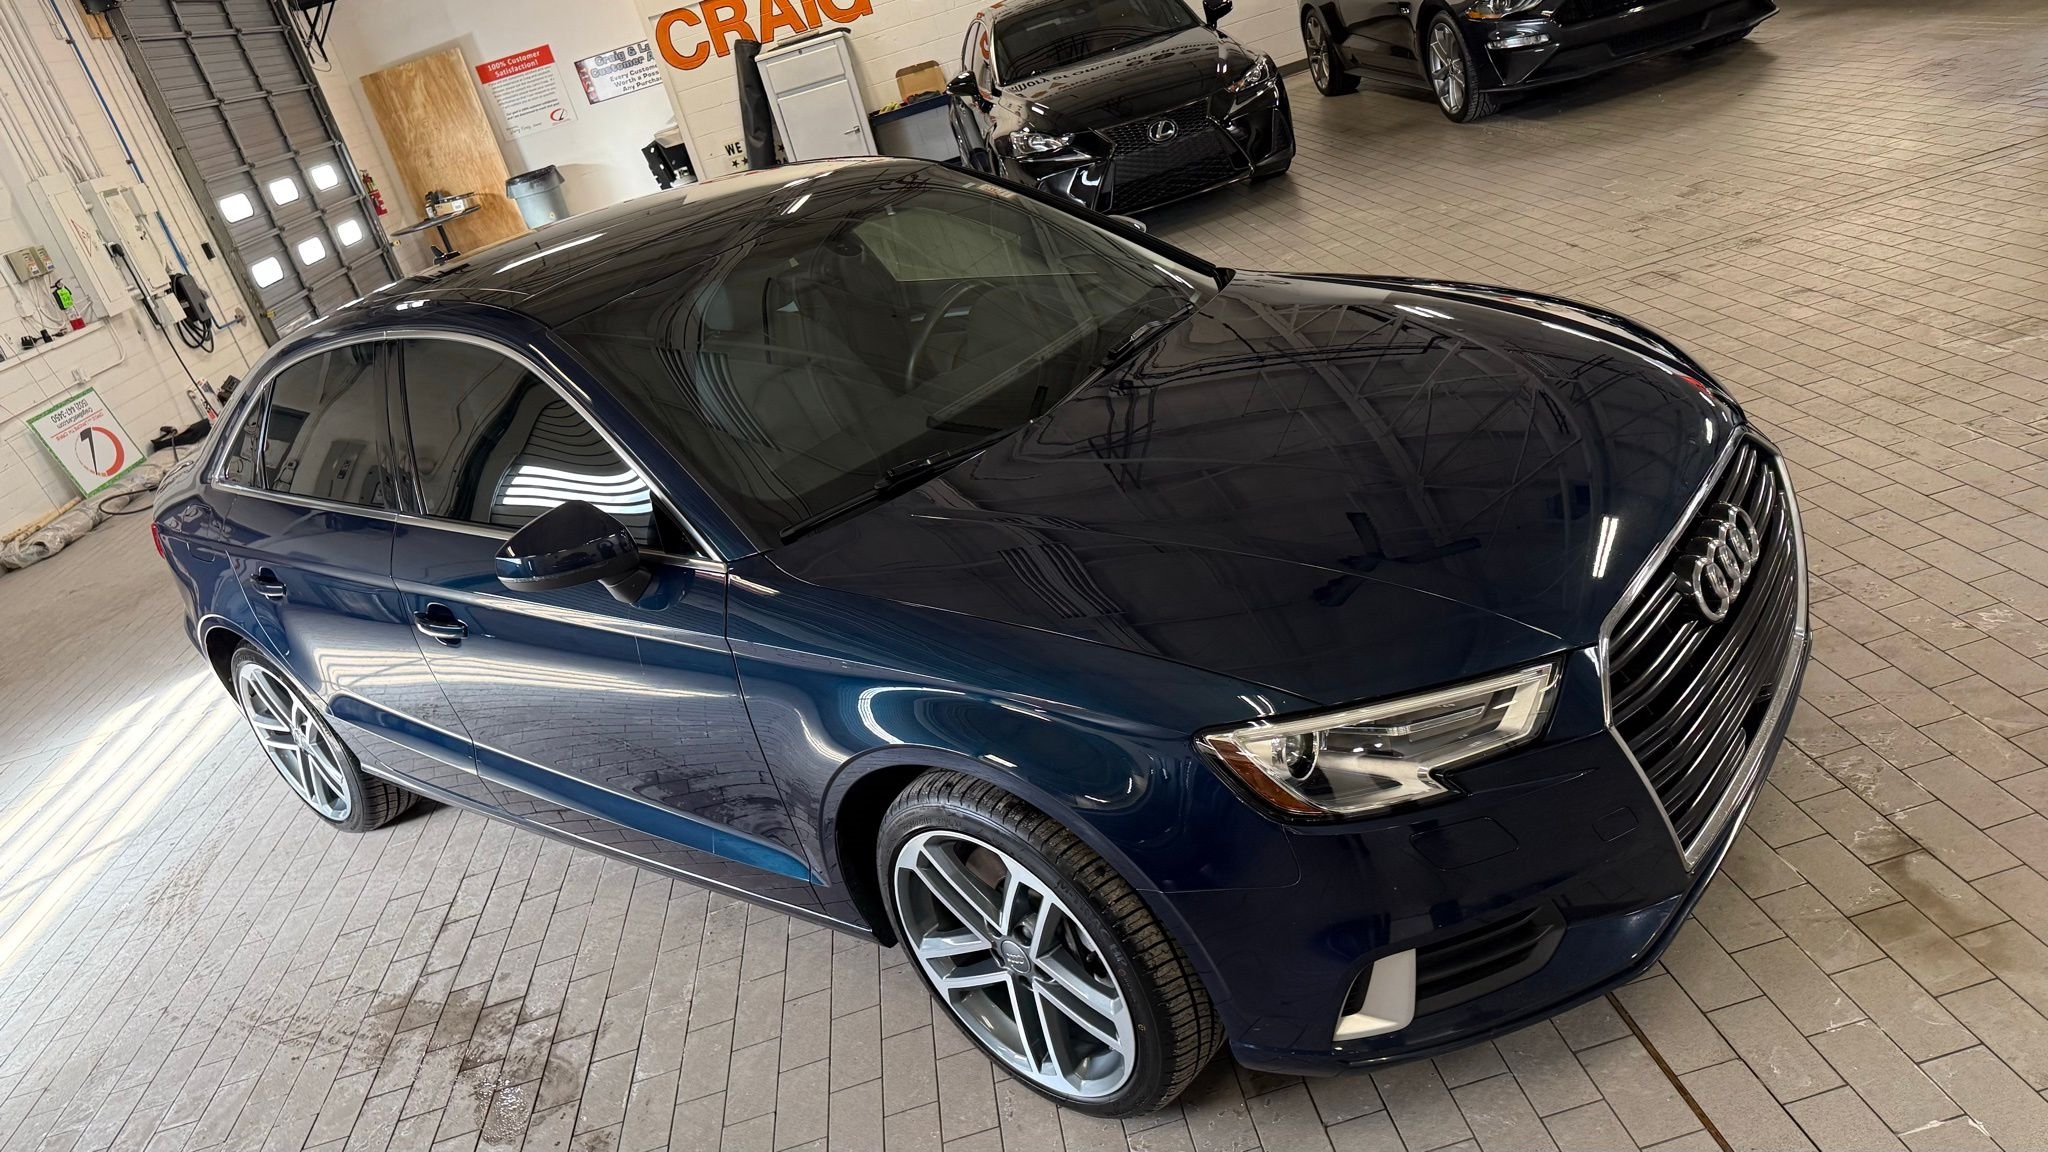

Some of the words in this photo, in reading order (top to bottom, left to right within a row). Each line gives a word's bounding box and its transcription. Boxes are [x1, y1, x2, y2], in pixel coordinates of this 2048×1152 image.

[487, 60, 507, 72] 100%
[507, 50, 541, 65] Customer
[591, 55, 645, 78] Customer
[594, 49, 626, 67] Craig
[626, 46, 637, 57] &
[494, 59, 539, 78] Satisfaction!
[724, 141, 743, 156] WE
